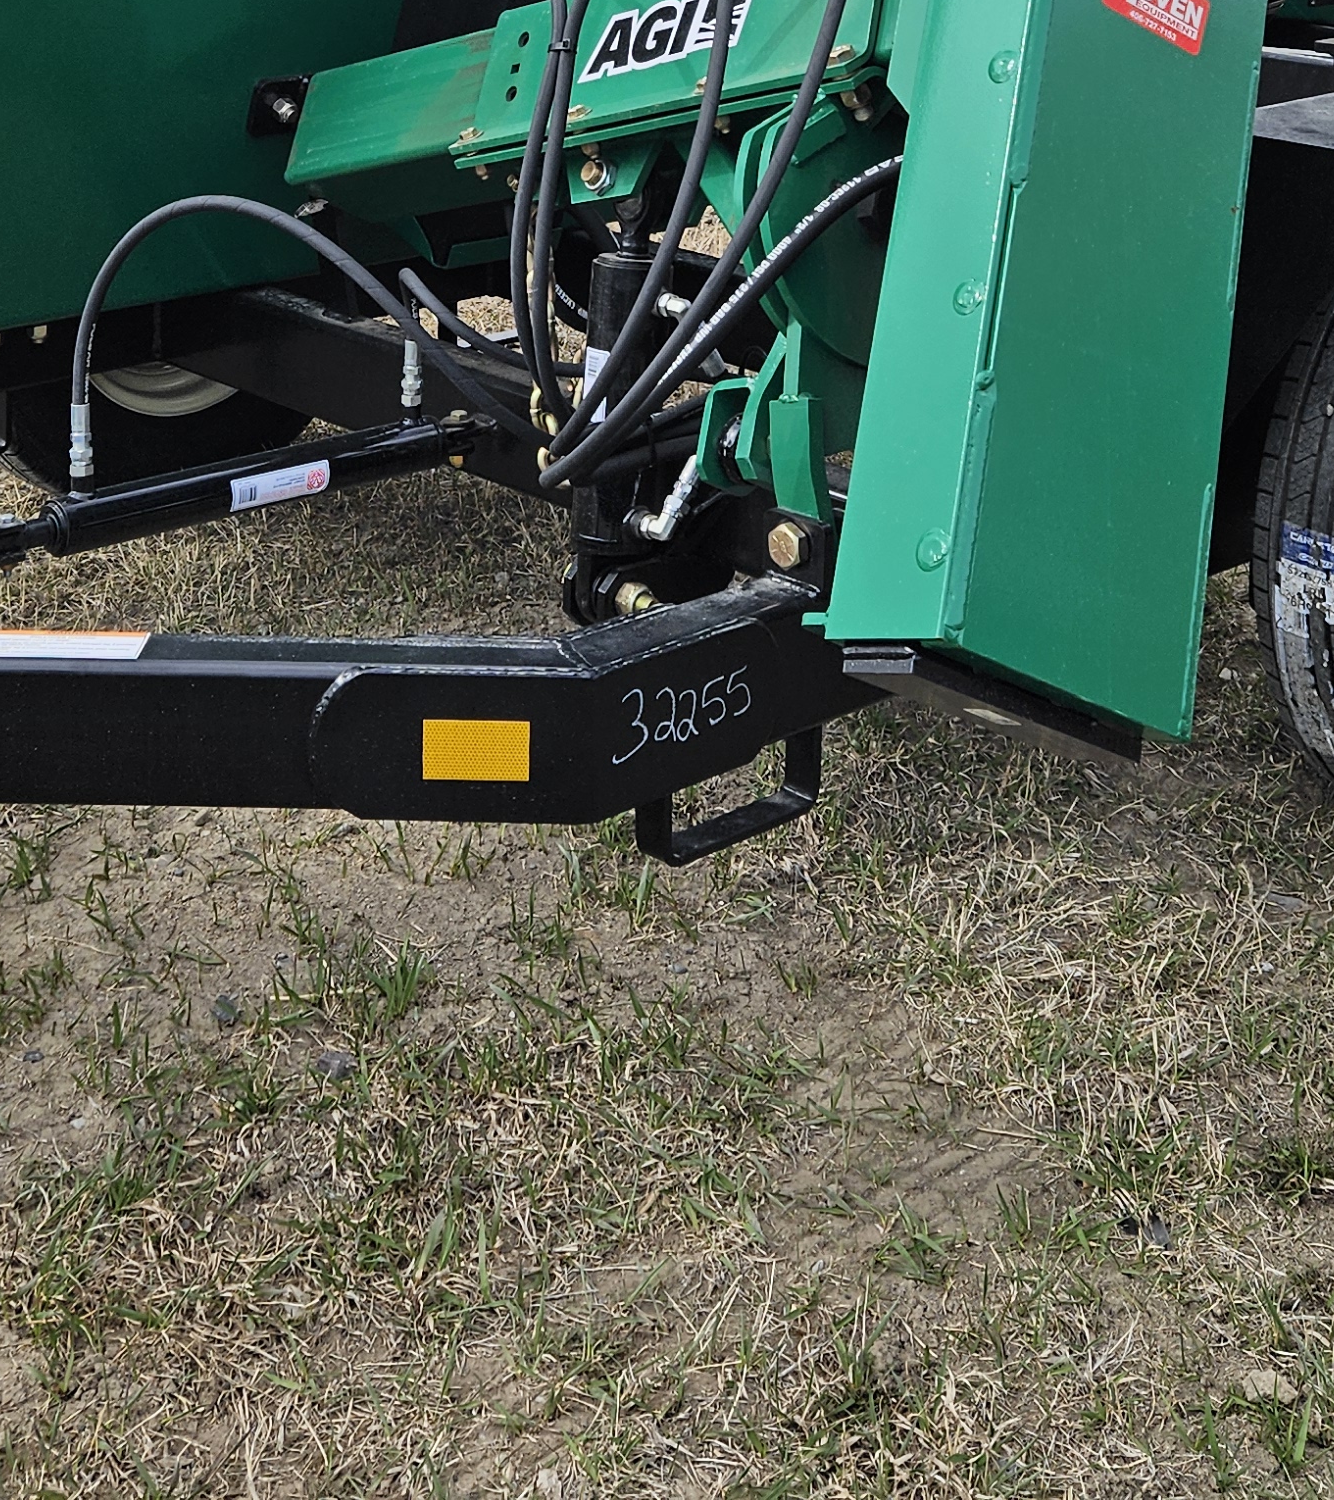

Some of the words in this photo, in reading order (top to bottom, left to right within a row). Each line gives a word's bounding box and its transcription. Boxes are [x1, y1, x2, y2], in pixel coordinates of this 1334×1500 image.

[587, 0, 701, 75] AGI
[1136, 0, 1196, 38] EQUIPMENT
[611, 664, 752, 765] 32255
